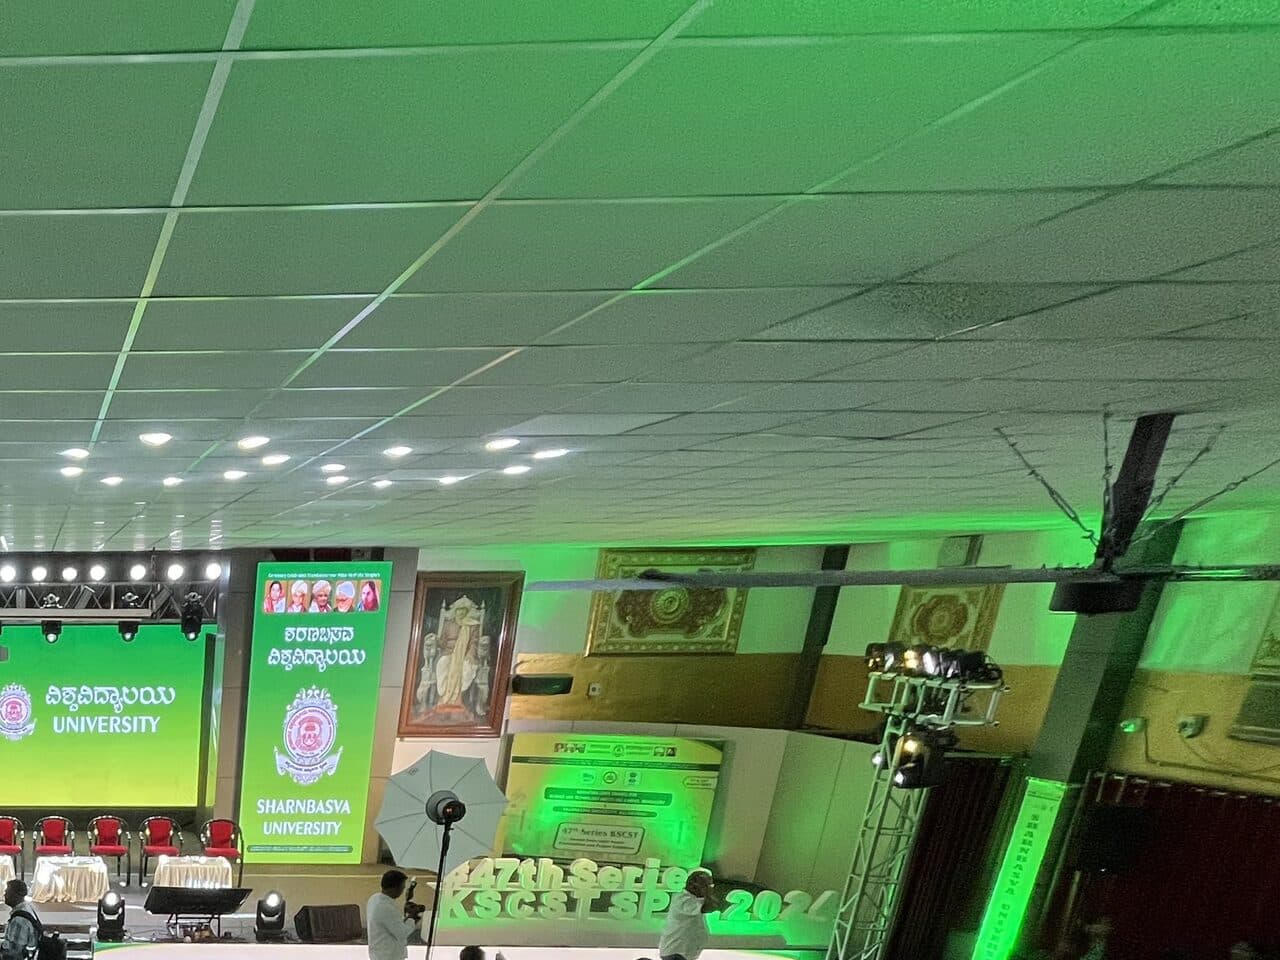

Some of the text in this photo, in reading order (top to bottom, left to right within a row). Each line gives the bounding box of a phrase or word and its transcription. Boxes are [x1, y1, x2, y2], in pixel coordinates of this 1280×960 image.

[53, 716, 161, 733] UNIVERSITY
[257, 799, 351, 815] SHARNBASVA
[263, 821, 342, 836] UNIVERSITY
[567, 858, 714, 892] Serie
[440, 889, 602, 921] KSCST
